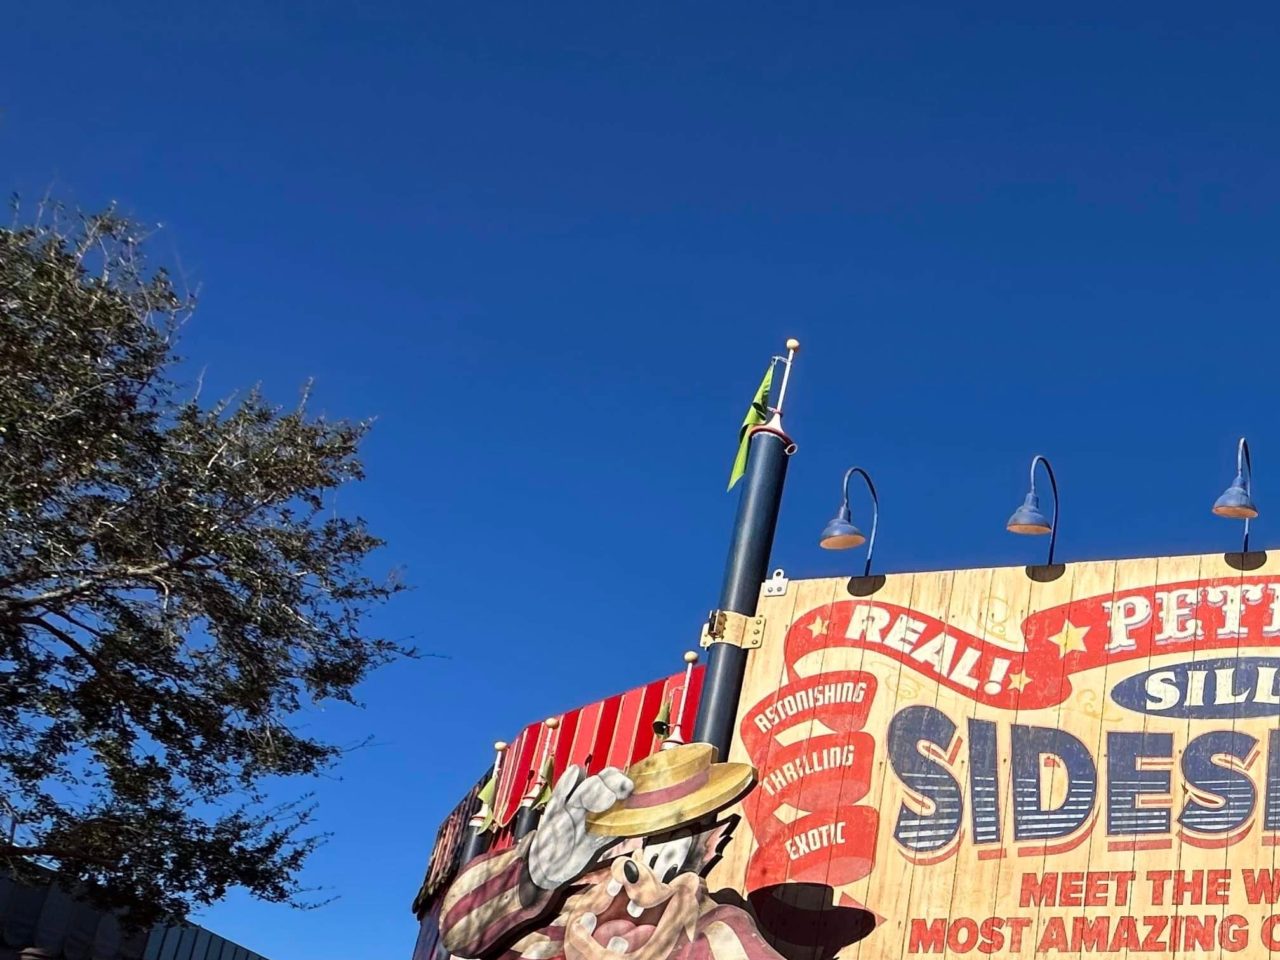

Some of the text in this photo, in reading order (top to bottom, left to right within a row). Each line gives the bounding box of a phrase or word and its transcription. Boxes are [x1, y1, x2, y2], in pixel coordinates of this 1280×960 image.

[845, 605, 1010, 695] REAL!
[754, 682, 867, 733] ASTONISHING
[760, 745, 854, 796] THRILLING
[784, 821, 846, 861] EXOTIC
[1019, 870, 1136, 907] MEET
[1146, 869, 1231, 905] THE
[908, 917, 1031, 953] MOST
[1038, 915, 1249, 953] AMAZING
